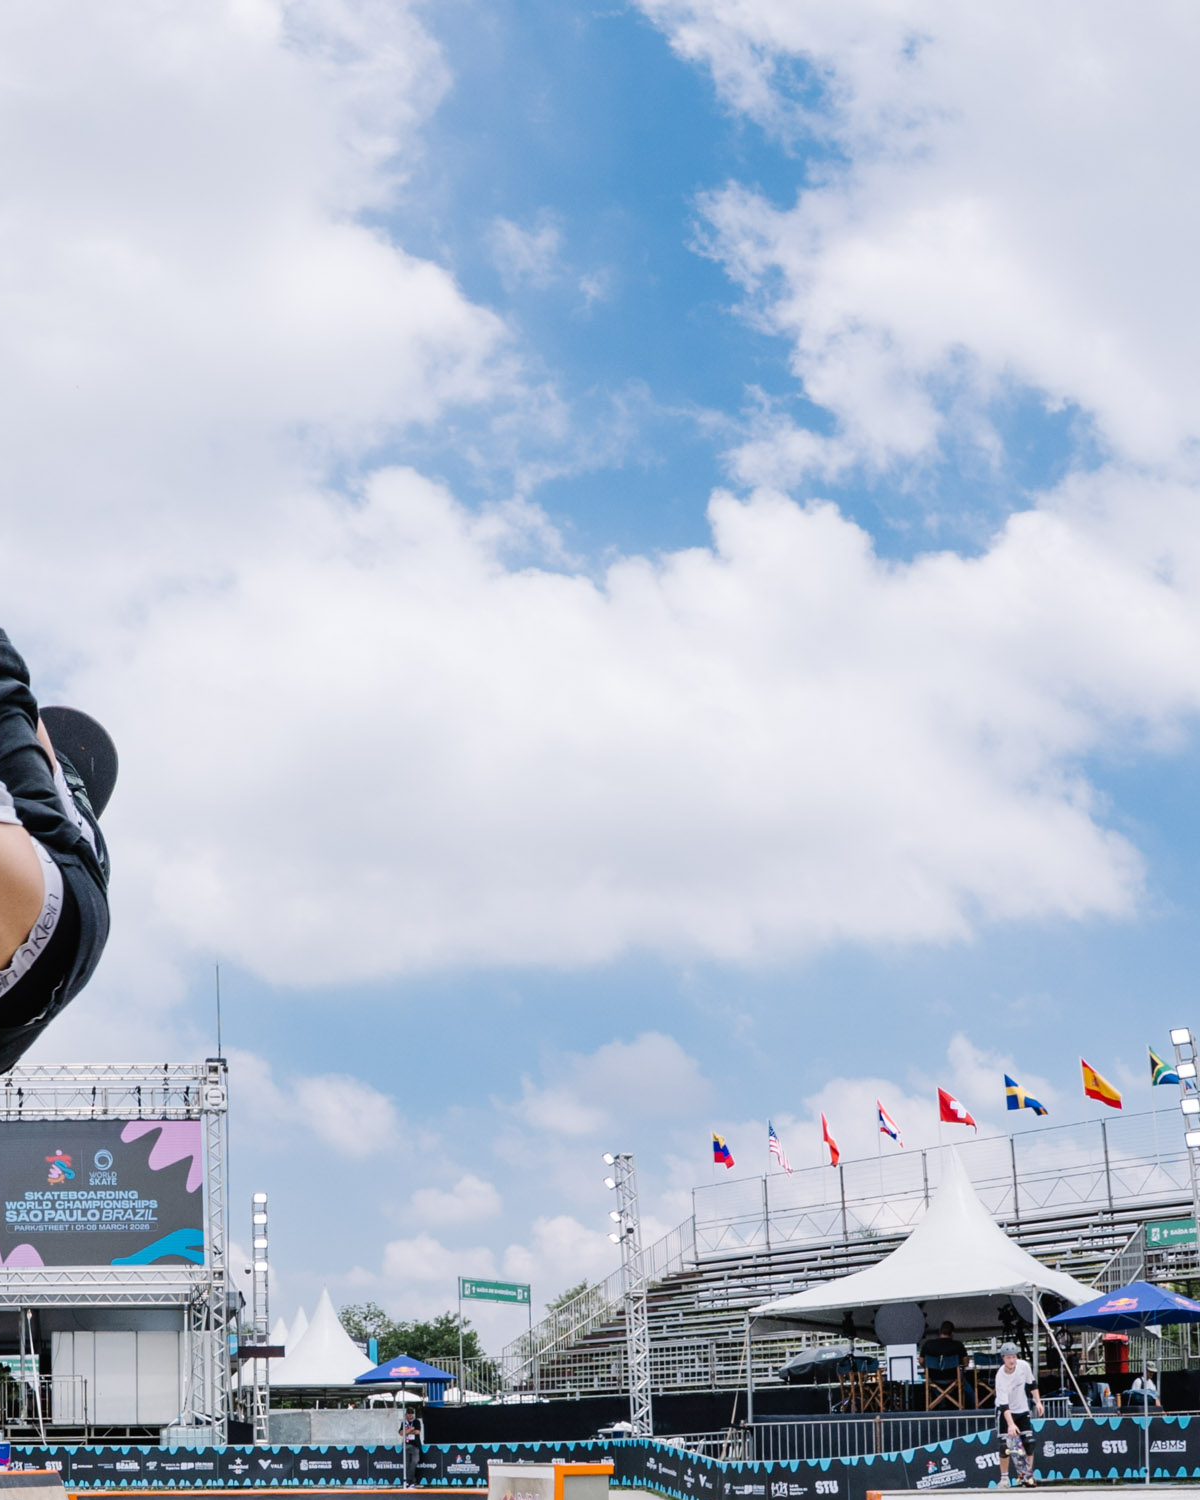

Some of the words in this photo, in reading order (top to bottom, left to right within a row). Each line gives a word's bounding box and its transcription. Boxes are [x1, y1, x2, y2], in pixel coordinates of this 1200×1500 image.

[89, 1178, 117, 1186] SKATE
[24, 1190, 139, 1200] SKATEBOARDING
[5, 1201, 52, 1210] WORLD
[55, 1200, 158, 1209] CHAMPIONSHIPS
[5, 1208, 43, 1222] SÃO
[44, 1209, 100, 1222] PAULO
[102, 1209, 158, 1221] BRAZIL
[1102, 1440, 1128, 1454] STU
[1150, 1440, 1186, 1452] ABMS
[45, 1461, 62, 1470] STU
[340, 1459, 360, 1469] STU
[975, 1452, 1000, 1469] STU
[815, 1480, 839, 1494] STU
